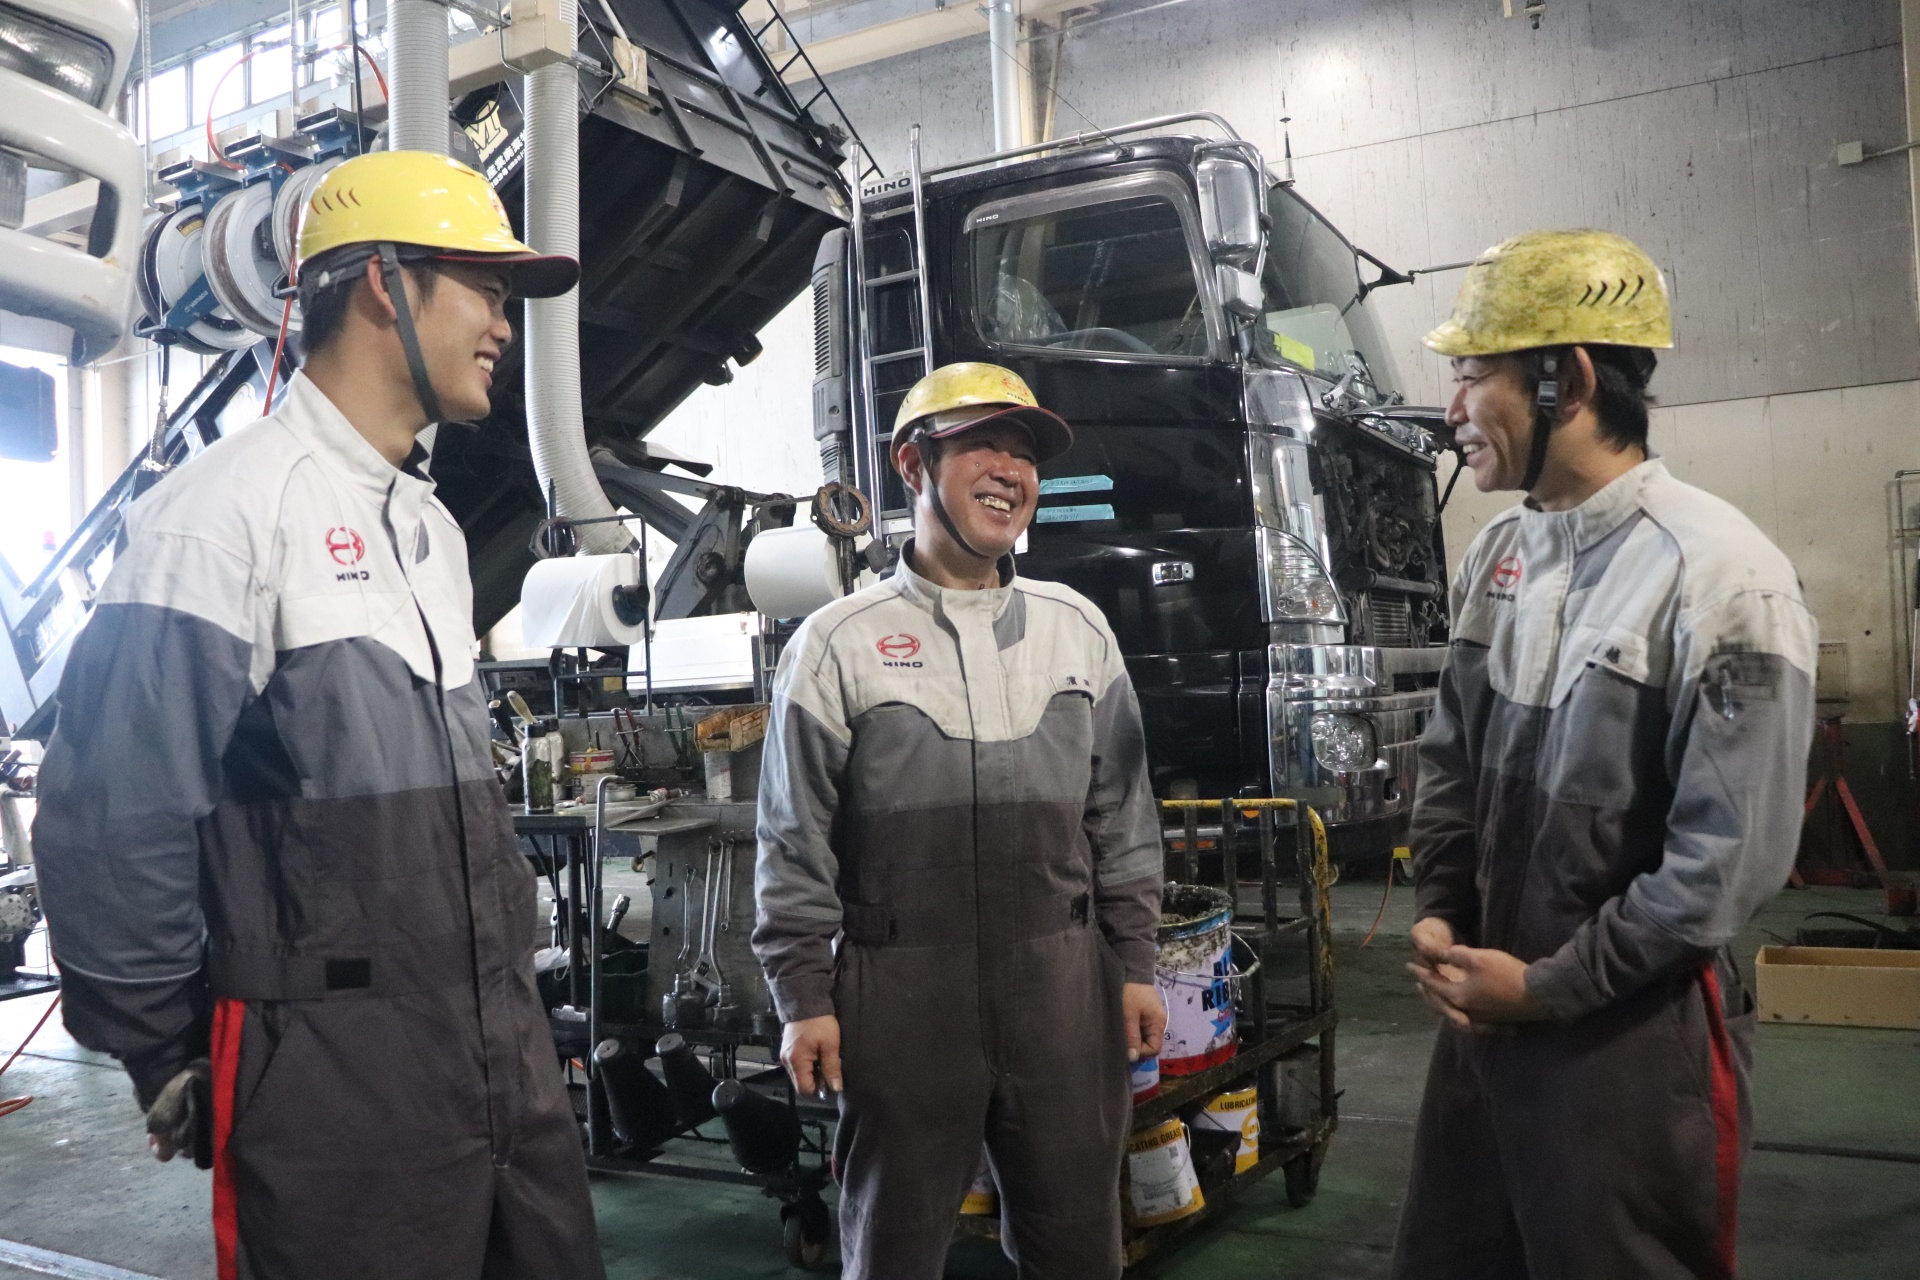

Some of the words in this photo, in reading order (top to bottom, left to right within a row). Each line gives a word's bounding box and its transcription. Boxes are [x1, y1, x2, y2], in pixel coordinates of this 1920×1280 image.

[863, 177, 911, 197] HINO
[976, 213, 999, 224] HINO
[336, 570, 370, 582] HINO
[883, 661, 924, 669] HINO
